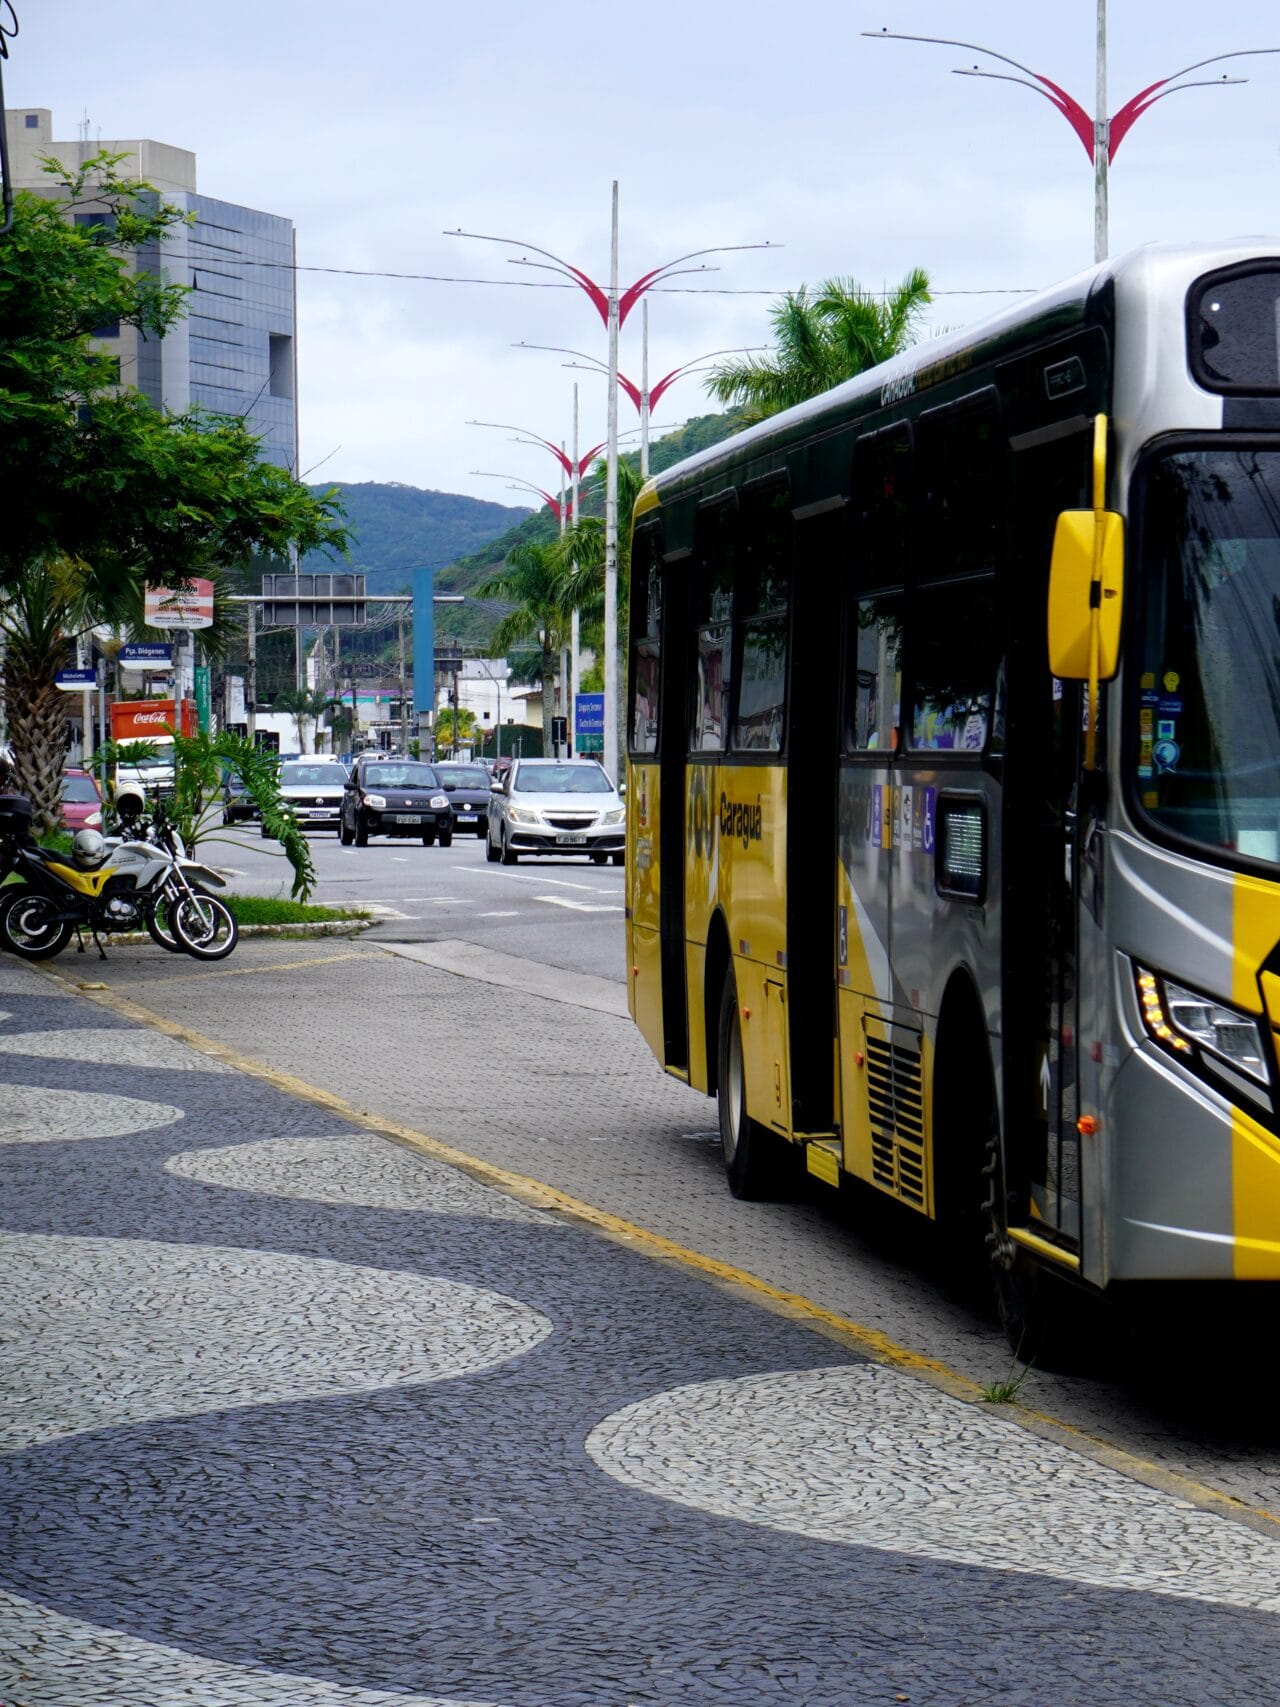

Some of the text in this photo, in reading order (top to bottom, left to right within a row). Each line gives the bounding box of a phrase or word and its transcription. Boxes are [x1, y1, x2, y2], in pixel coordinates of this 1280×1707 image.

[125, 646, 165, 656] Pça. Diógenes
[719, 791, 762, 850] Caraguá
